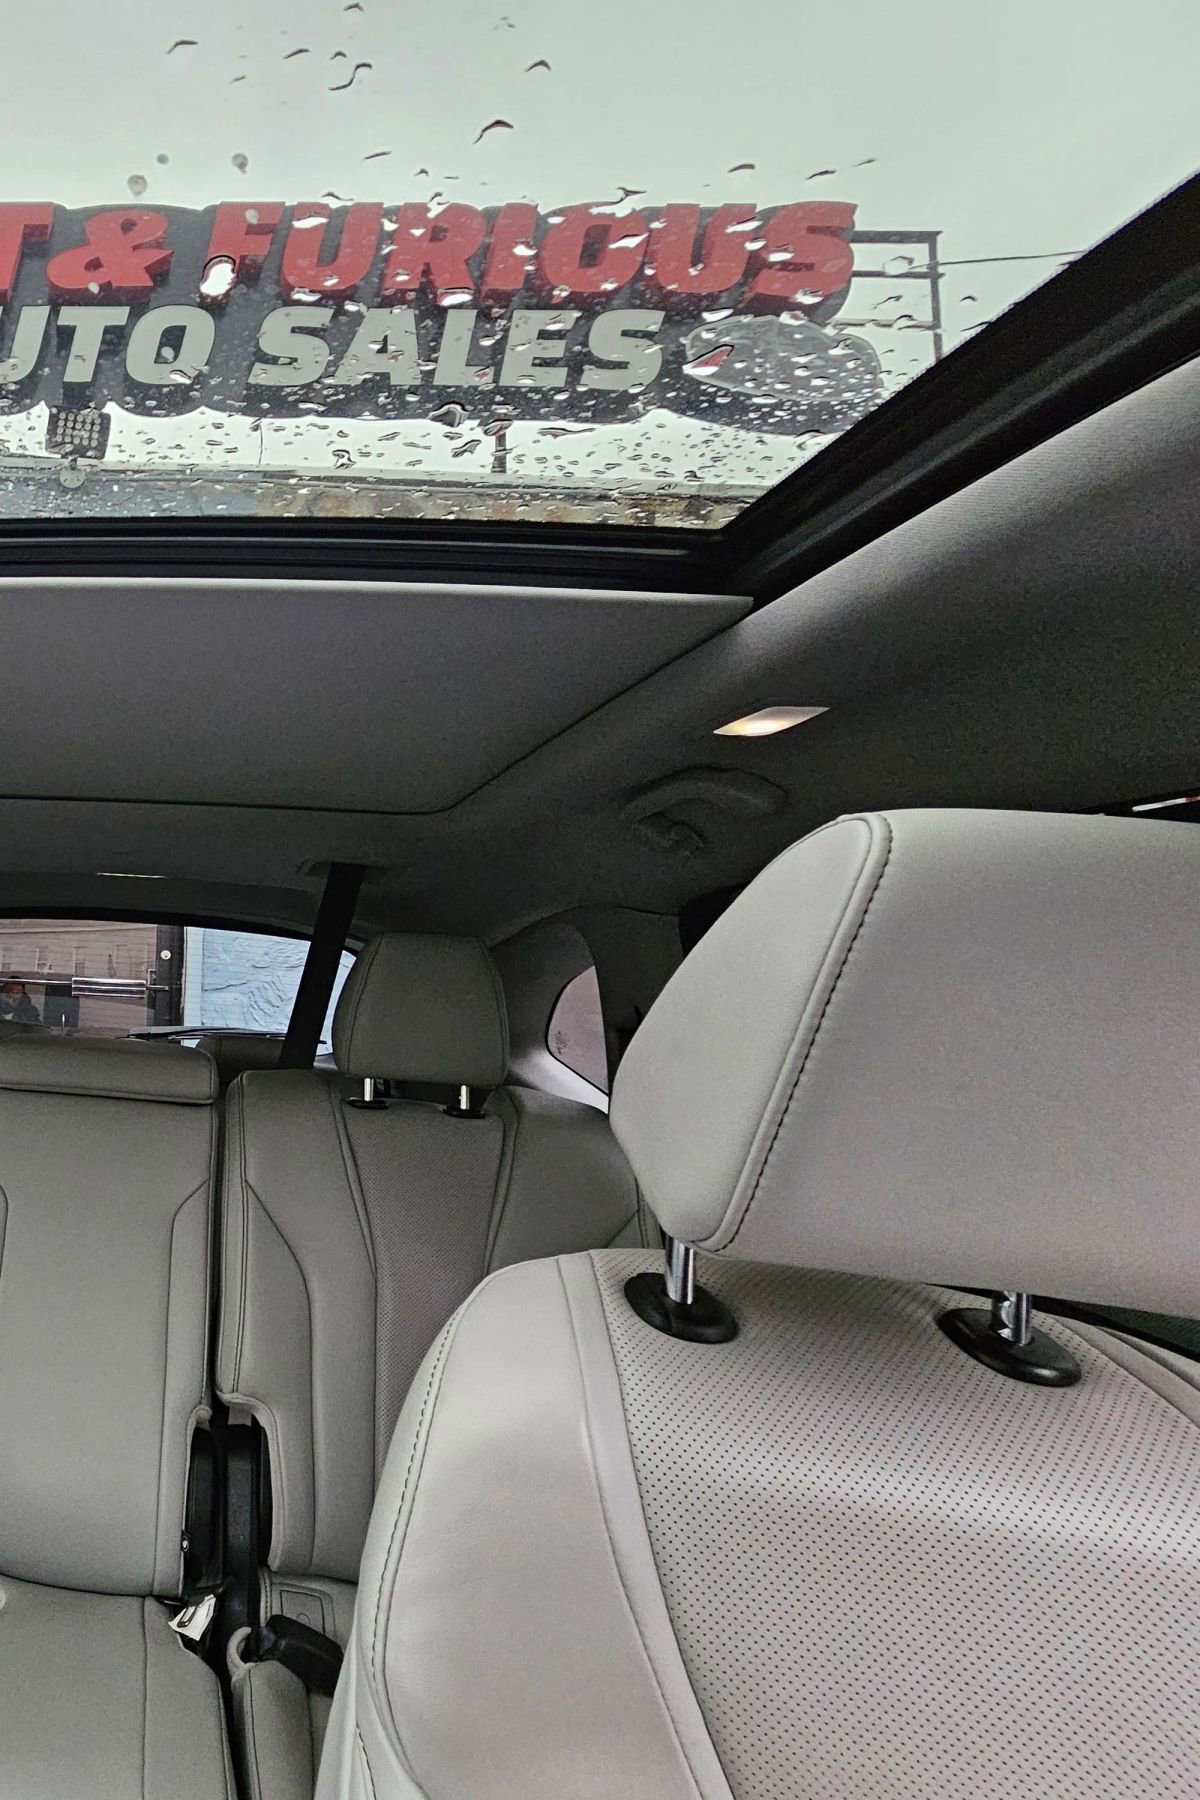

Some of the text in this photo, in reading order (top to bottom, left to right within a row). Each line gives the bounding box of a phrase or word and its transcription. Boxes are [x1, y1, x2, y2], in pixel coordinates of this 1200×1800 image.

[46, 210, 174, 295] &
[204, 201, 857, 310] FURIOUS
[247, 308, 665, 391] SALES
